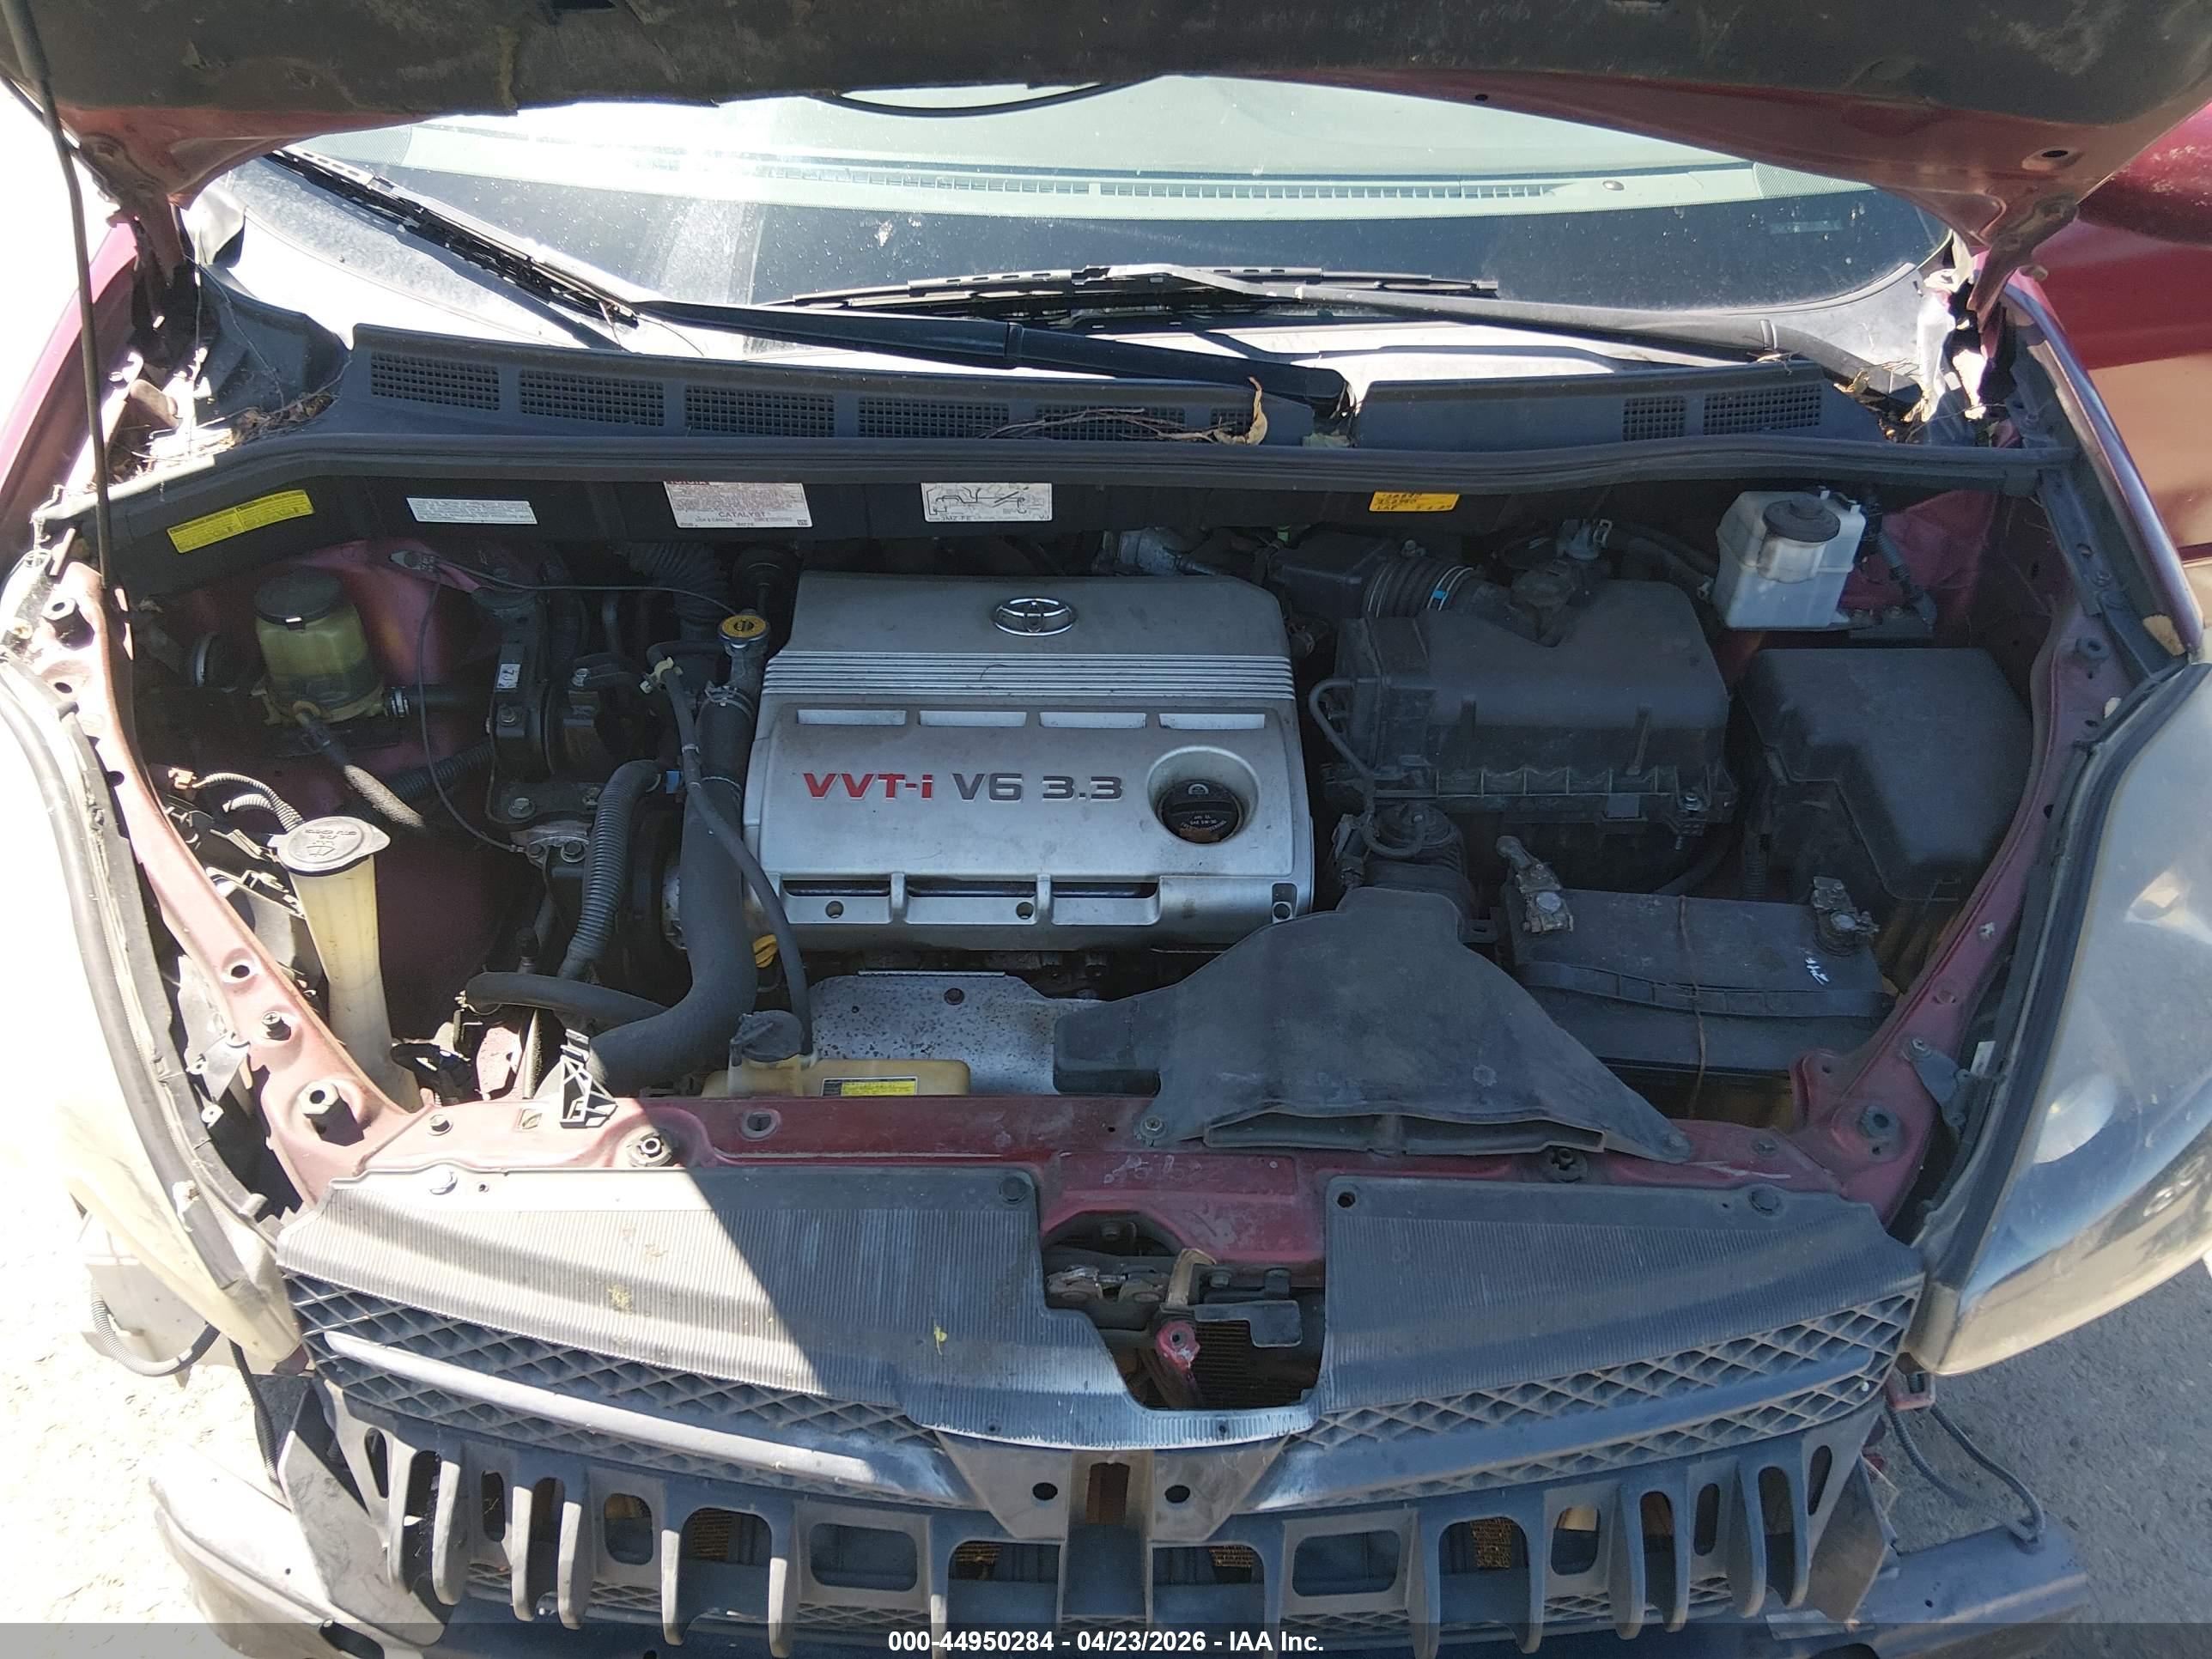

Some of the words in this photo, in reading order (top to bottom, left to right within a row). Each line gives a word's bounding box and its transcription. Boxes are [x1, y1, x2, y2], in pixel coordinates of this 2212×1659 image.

[803, 772, 933, 800] VVT-i
[952, 773, 1023, 802] V6
[1042, 775, 1123, 801] 3.3
